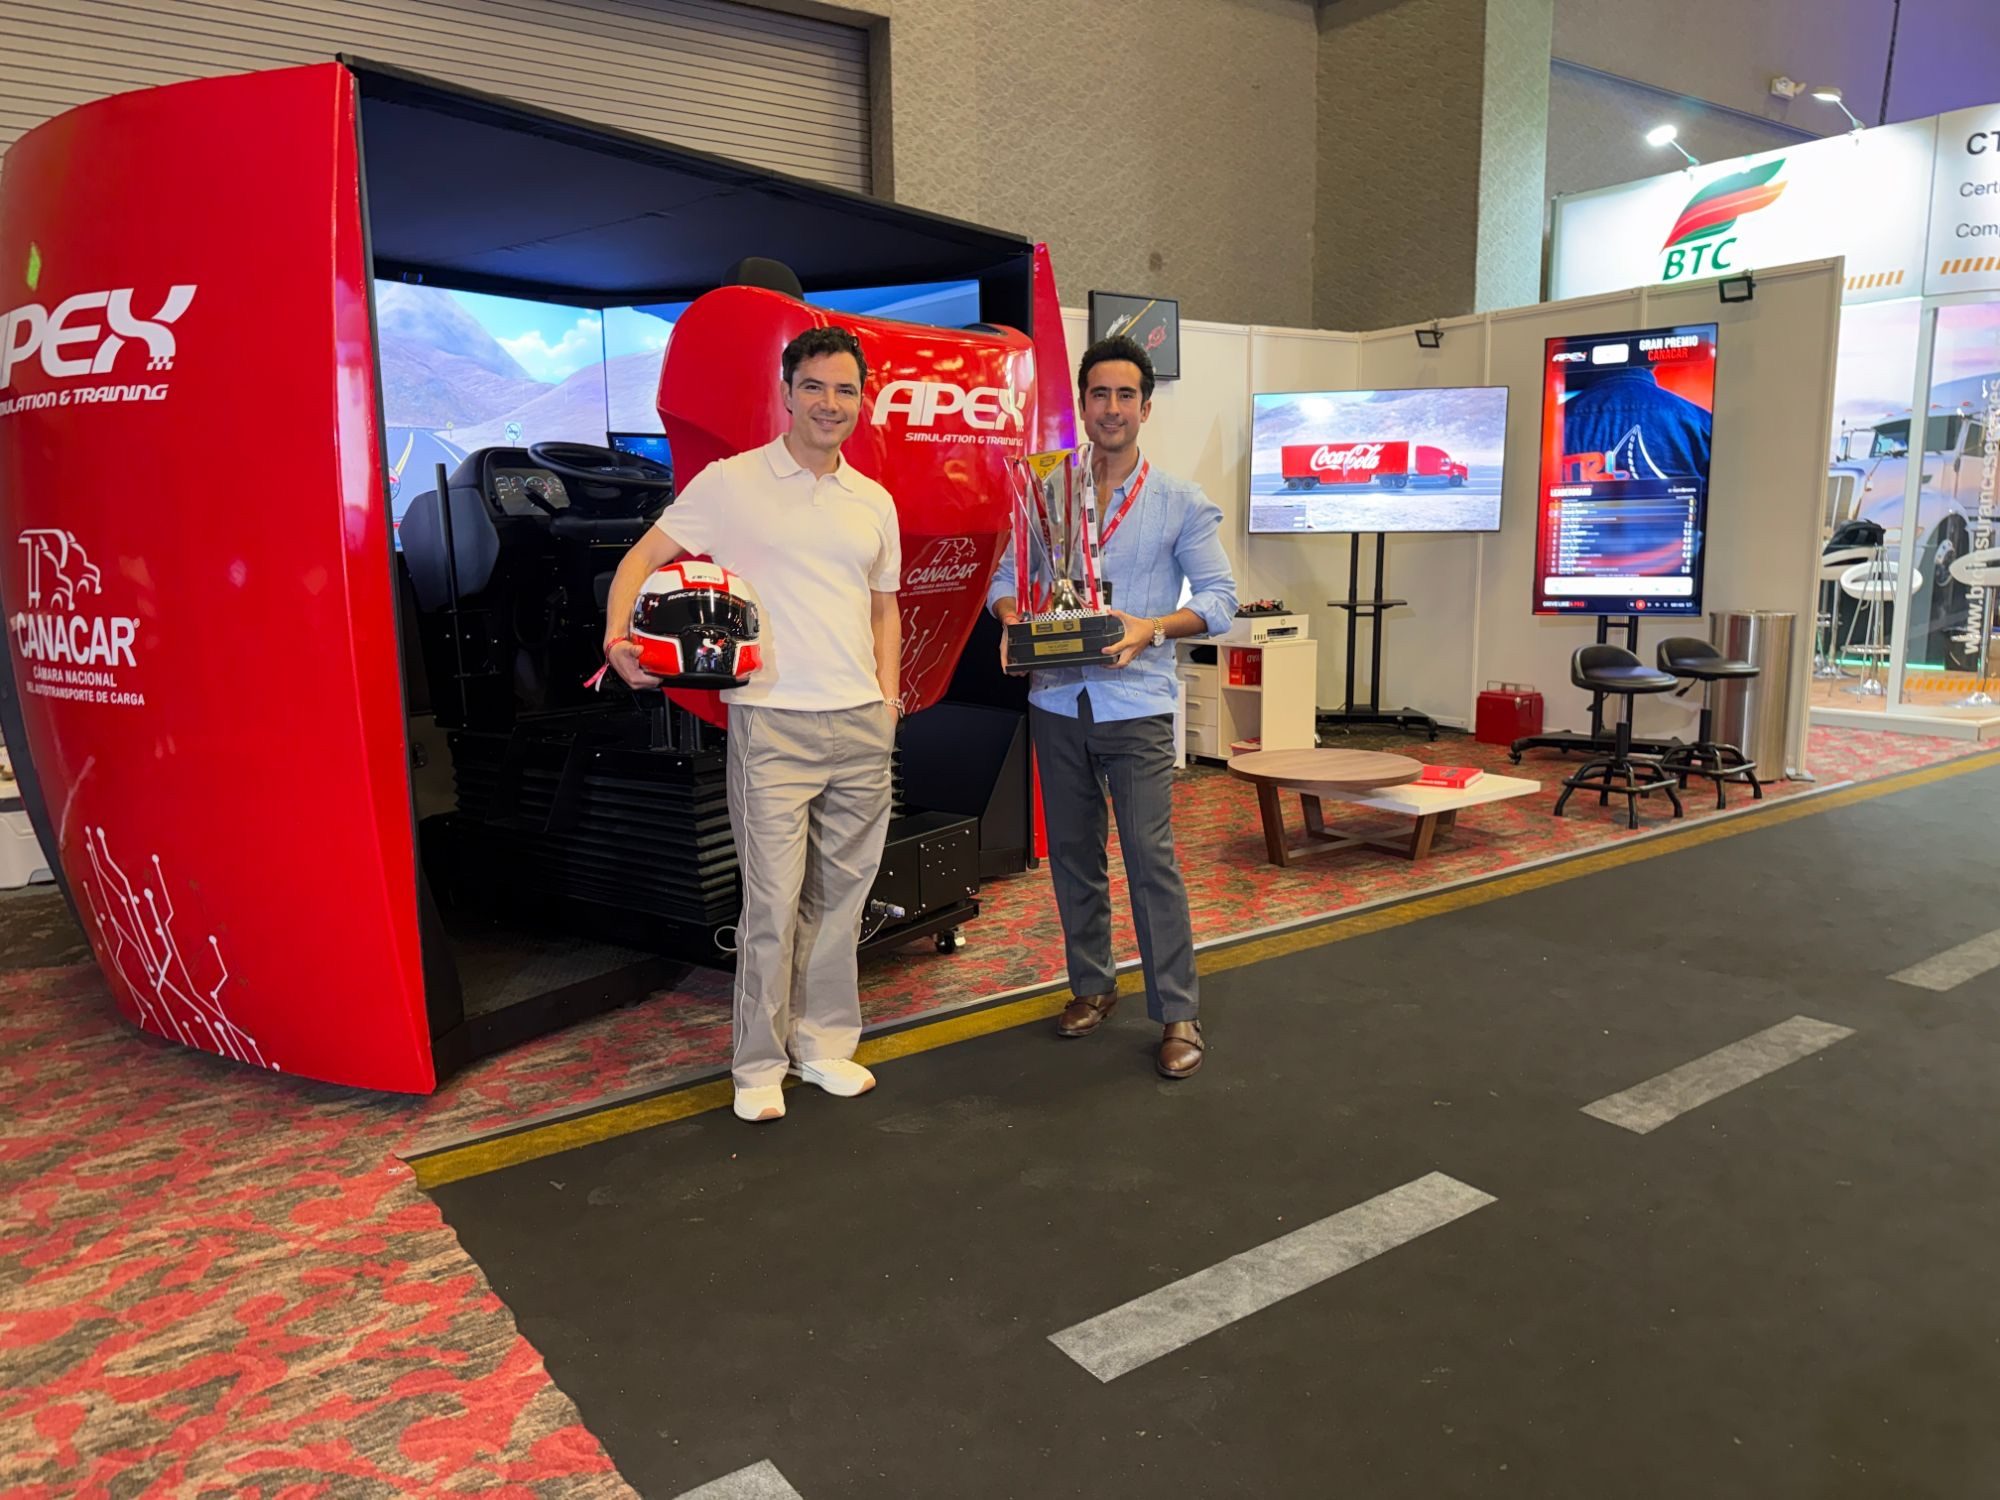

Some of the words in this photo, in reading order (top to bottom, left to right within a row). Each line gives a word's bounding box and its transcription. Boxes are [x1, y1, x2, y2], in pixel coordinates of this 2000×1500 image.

[1959, 180, 2000, 198] Cert
[1955, 222, 2000, 239] Com
[1662, 237, 1738, 281] BTC
[0, 284, 198, 390] PEX
[1664, 335, 1699, 349] PREMIO
[59, 389, 71, 406] &
[73, 384, 169, 404] TRAINING
[870, 380, 1026, 432] APEX
[904, 432, 976, 444] SIMULATION
[977, 435, 985, 444] &
[986, 436, 1024, 447] TRAINING
[906, 562, 979, 585] CANACAR
[667, 591, 696, 601] RACE
[17, 612, 137, 667] CANACAR
[65, 670, 117, 687] NACIONAL
[96, 690, 108, 703] DE
[110, 692, 145, 706] CARGA
